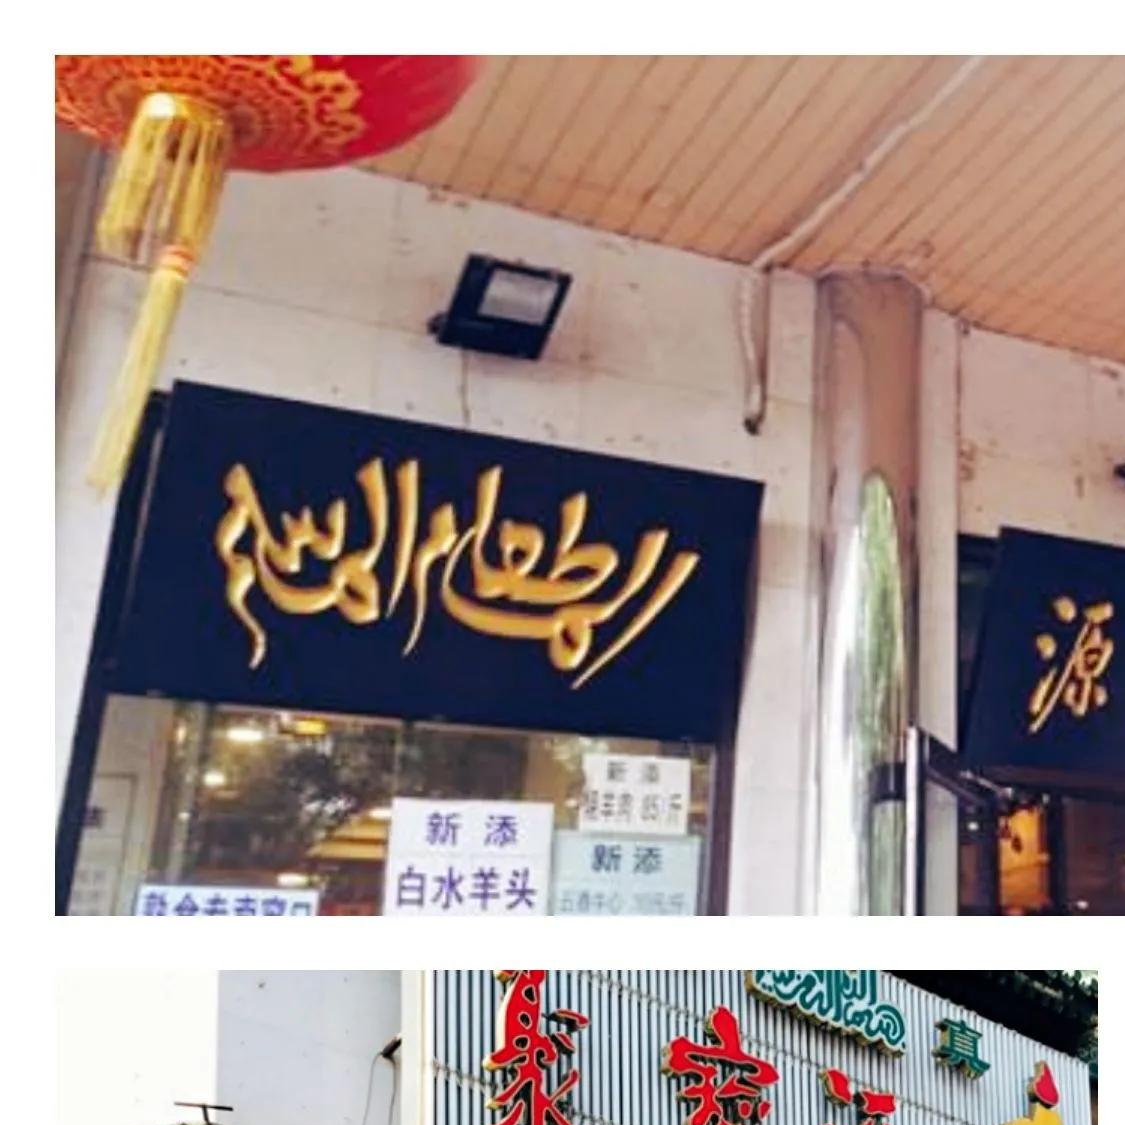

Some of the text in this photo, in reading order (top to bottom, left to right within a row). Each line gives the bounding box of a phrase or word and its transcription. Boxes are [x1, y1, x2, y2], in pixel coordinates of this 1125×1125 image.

[426, 811, 519, 849] 新添
[397, 865, 538, 911] 白水羊头
